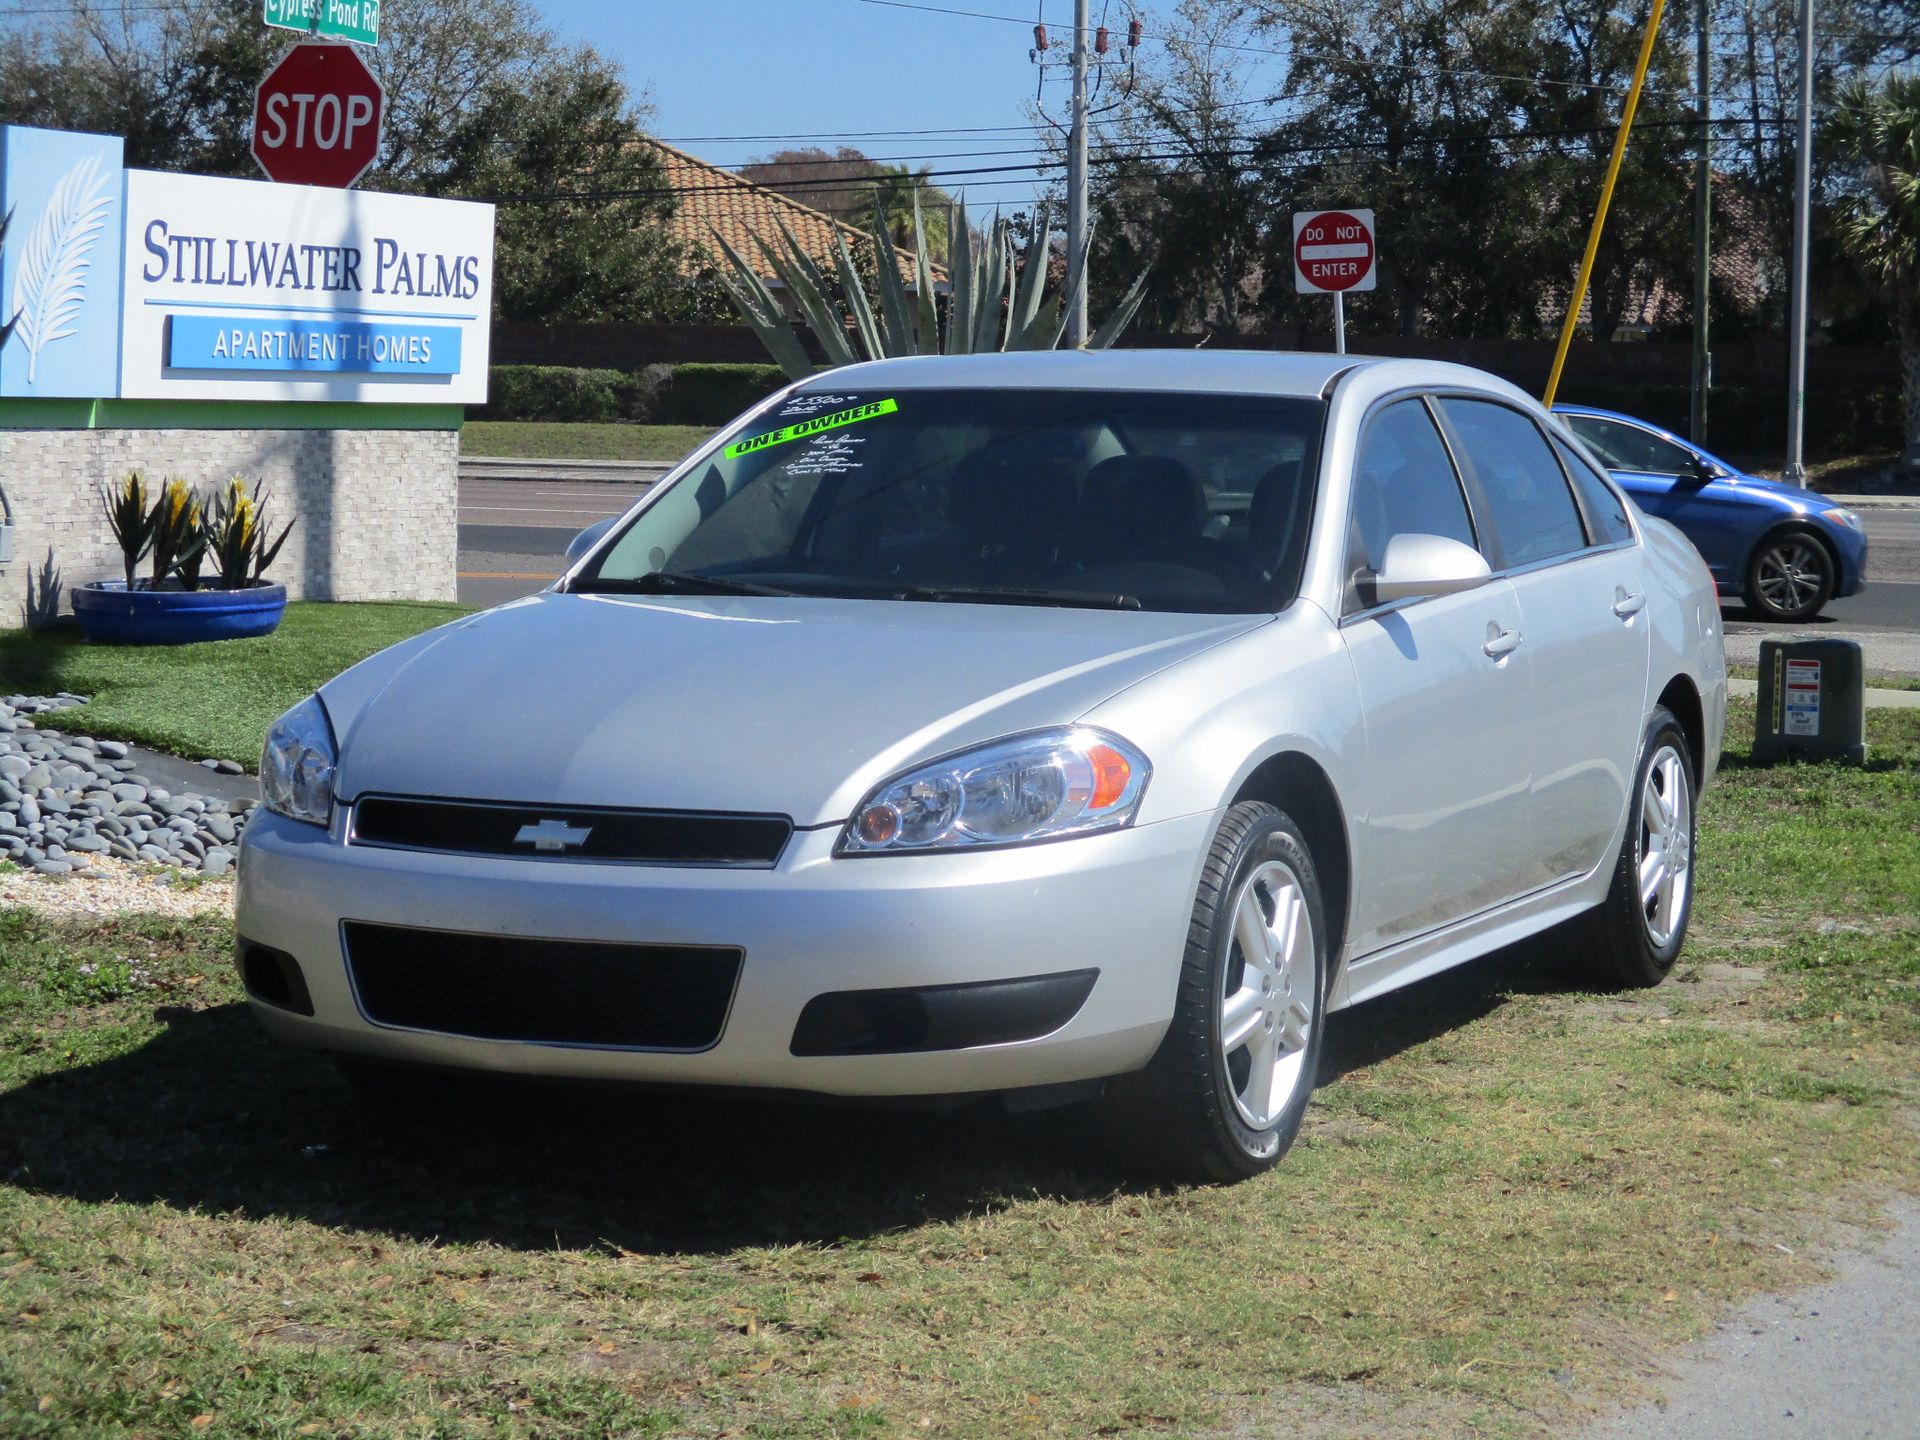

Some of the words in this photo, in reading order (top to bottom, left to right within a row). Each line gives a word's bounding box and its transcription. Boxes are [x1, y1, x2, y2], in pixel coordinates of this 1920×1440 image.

[329, 0, 358, 28] Pond
[363, 2, 377, 32] Rd
[262, 92, 373, 150] STOP
[1306, 227, 1324, 241] DO
[1336, 226, 1361, 240] NOT
[143, 219, 363, 292] STILLWATER
[372, 237, 479, 300] PALMS
[1312, 262, 1358, 277] ENTER
[212, 329, 351, 361] APARTMENT
[357, 334, 432, 363] HOMES
[735, 429, 787, 454] ONE
[793, 402, 882, 436] OWNER
